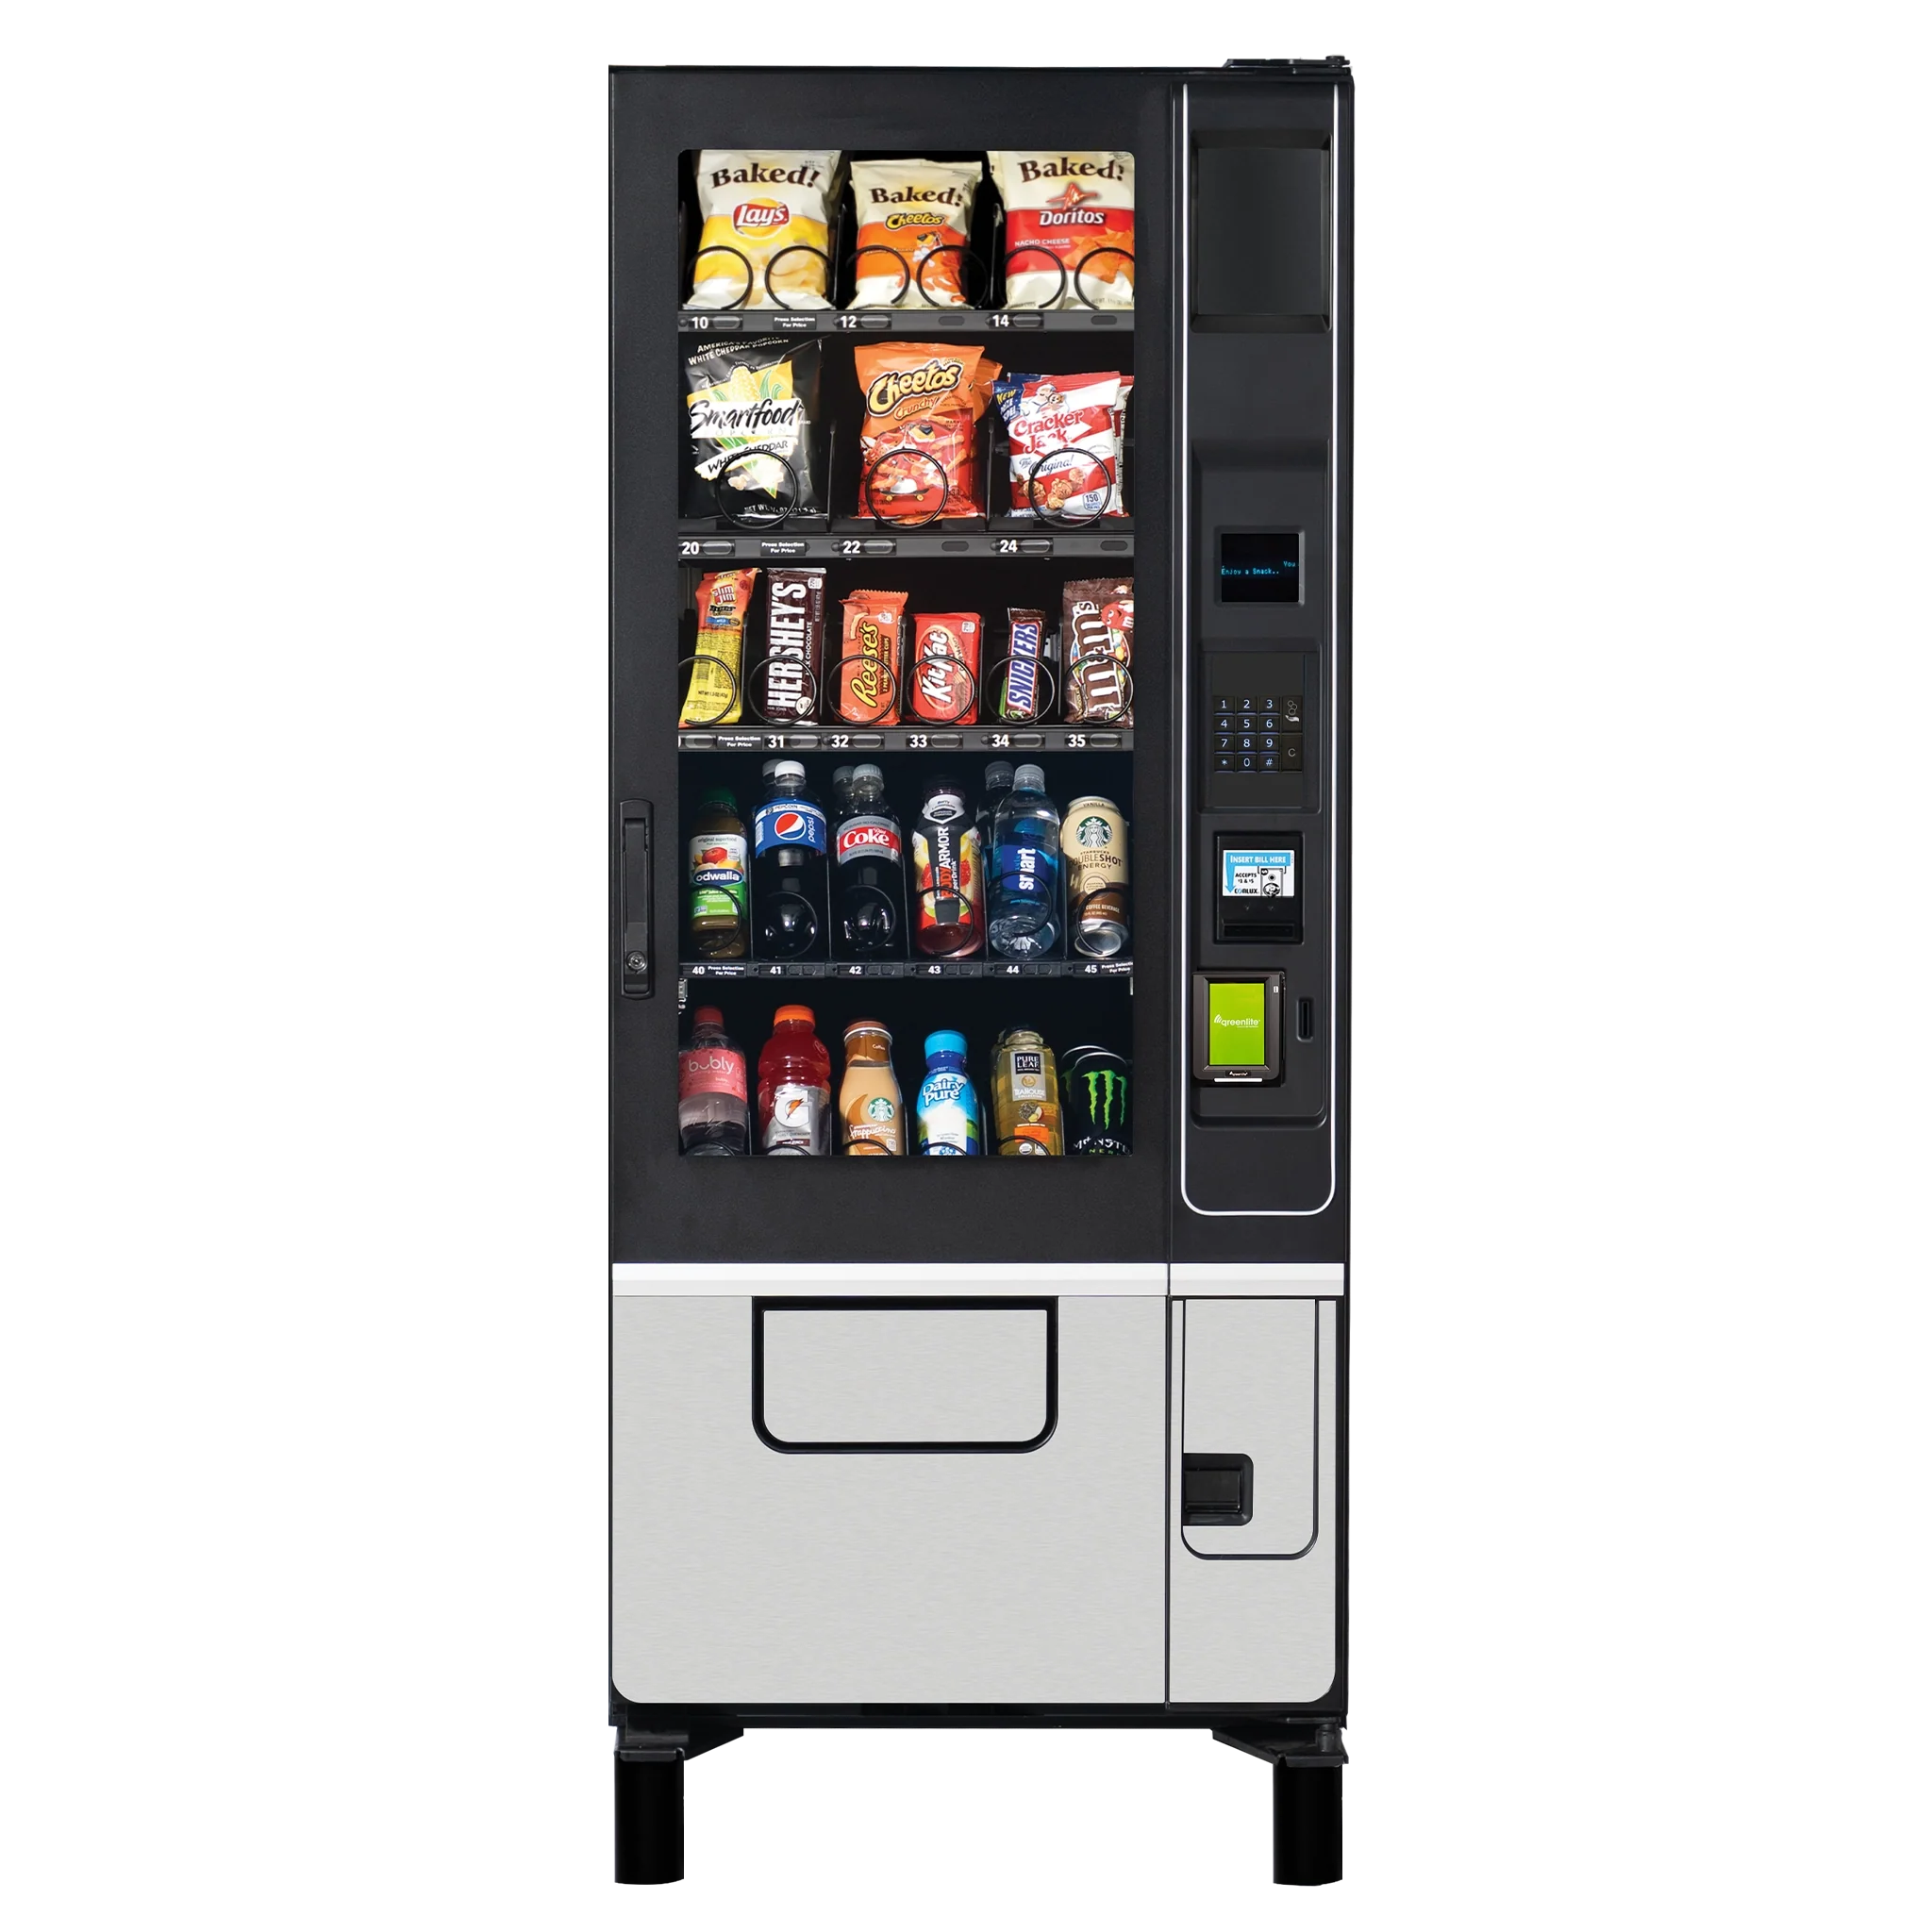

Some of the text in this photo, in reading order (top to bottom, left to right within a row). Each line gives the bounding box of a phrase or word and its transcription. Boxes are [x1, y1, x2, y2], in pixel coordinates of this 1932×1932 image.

[710, 163, 821, 188] Baked!
[1017, 157, 1124, 183] Baked!
[869, 187, 963, 208] Baked!
[885, 212, 945, 229] Cheetos
[1039, 208, 1106, 225] Doritos
[1014, 239, 1041, 247] NACHO
[691, 317, 708, 329] 10
[841, 316, 857, 328] 12
[992, 314, 1009, 327] 14
[688, 352, 715, 366] WHITE
[715, 344, 751, 358] CHEDDAR
[867, 359, 962, 416] Cheetos
[894, 395, 941, 420] Crunchy
[689, 398, 801, 435] Smartfood
[1013, 409, 1086, 437] Cracker
[681, 541, 700, 555] 20
[842, 541, 860, 554] 22
[1000, 540, 1017, 553] 24
[767, 582, 807, 708] HERSHEY'S
[851, 621, 879, 708] Reese's
[1221, 699, 1227, 708] 1
[1243, 699, 1251, 708] 2
[1266, 699, 1274, 708] 3
[1221, 719, 1227, 728] 4
[1243, 719, 1251, 728] 5
[1266, 719, 1274, 728] 6
[768, 735, 785, 748] 31
[831, 735, 849, 748] 32
[909, 735, 927, 748] 33
[991, 734, 1009, 748] 34
[1068, 734, 1086, 748] 35
[1221, 739, 1227, 748] 7
[1243, 739, 1251, 748] 8
[1266, 739, 1274, 748] 9
[1288, 748, 1296, 757] C
[1243, 758, 1251, 767] 0
[806, 815, 816, 843] pepsi
[843, 828, 891, 849] Coke
[1230, 855, 1254, 863] INSERT
[696, 871, 740, 882] odwalla
[691, 966, 705, 974] 40
[770, 966, 781, 974] 41
[849, 966, 862, 974] 42
[927, 966, 941, 974] 43
[1006, 965, 1020, 974] 44
[1084, 964, 1097, 974] 45
[1221, 1017, 1259, 1027] greenlite
[689, 1056, 735, 1075] bubly
[923, 1079, 964, 1096] Dairy
[774, 1090, 814, 1128] G
